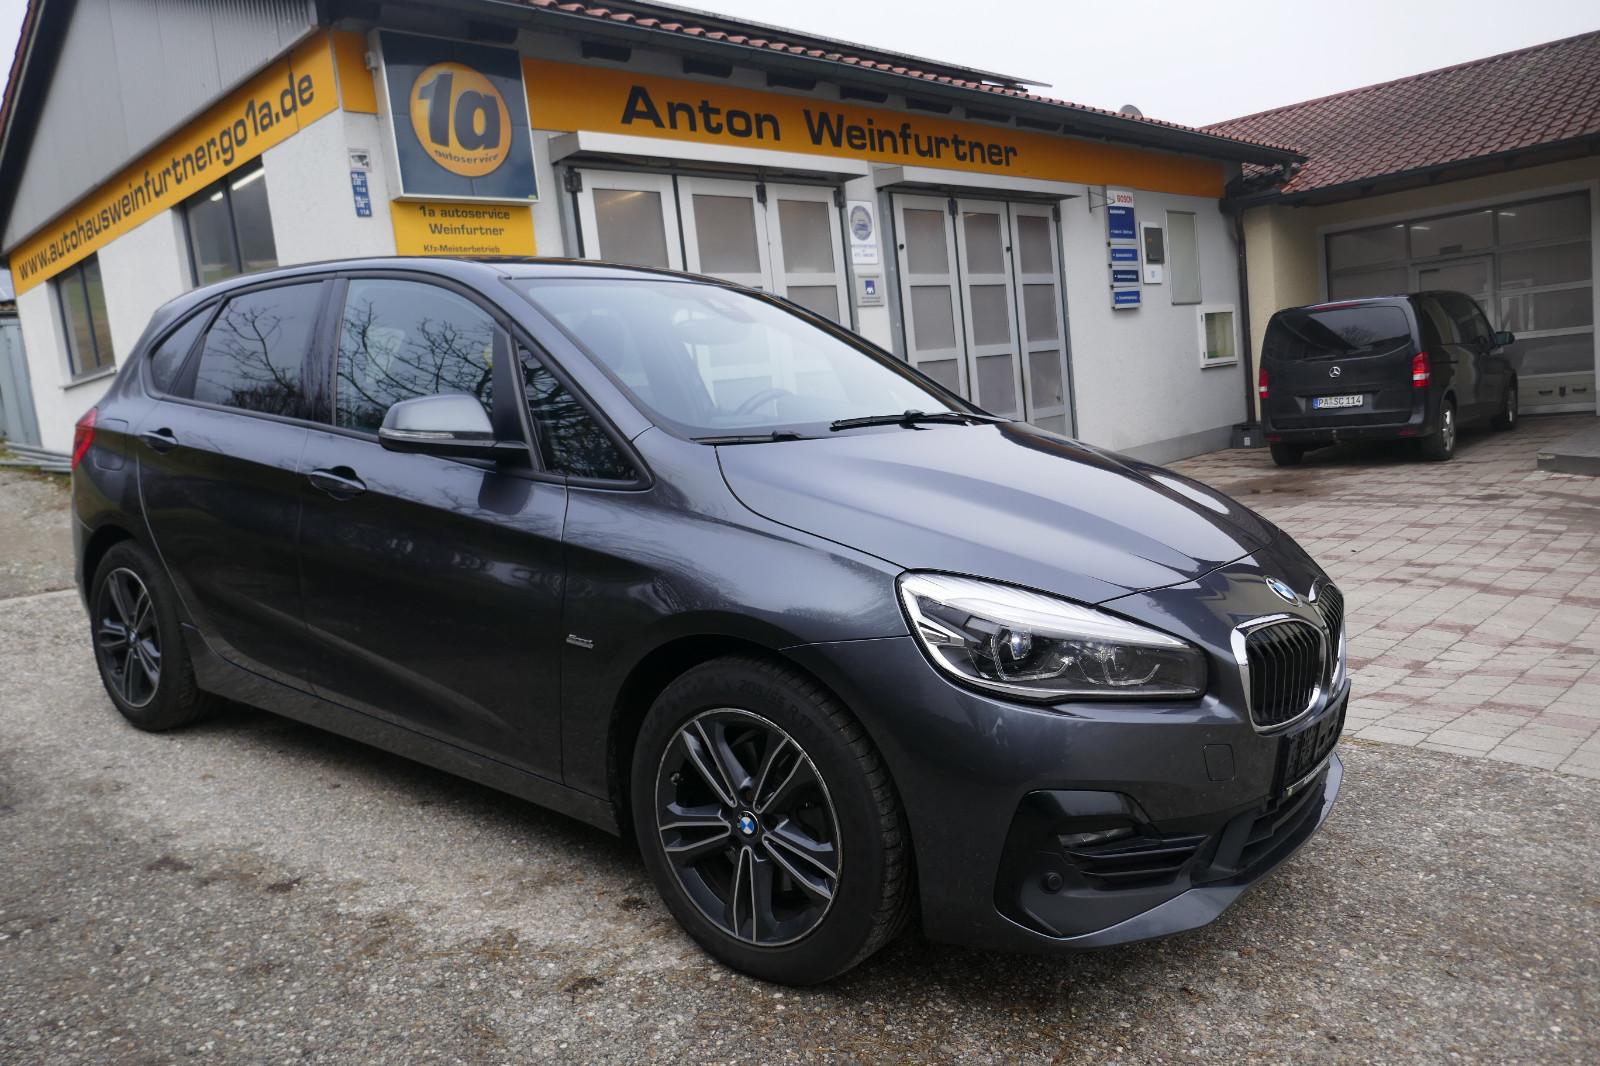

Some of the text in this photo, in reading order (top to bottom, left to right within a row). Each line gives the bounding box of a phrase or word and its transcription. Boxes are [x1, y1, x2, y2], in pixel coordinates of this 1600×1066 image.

[418, 72, 501, 151] 1a
[621, 85, 1018, 168] Anton Weinfurtner
[434, 148, 499, 164] autoservice
[18, 72, 315, 281] www.autohausweinfurtner.go1a.de
[419, 205, 510, 220] 1a autoservice
[428, 223, 505, 236] Weinfurtner
[423, 244, 501, 253] Kfz-Meisterbetrieb
